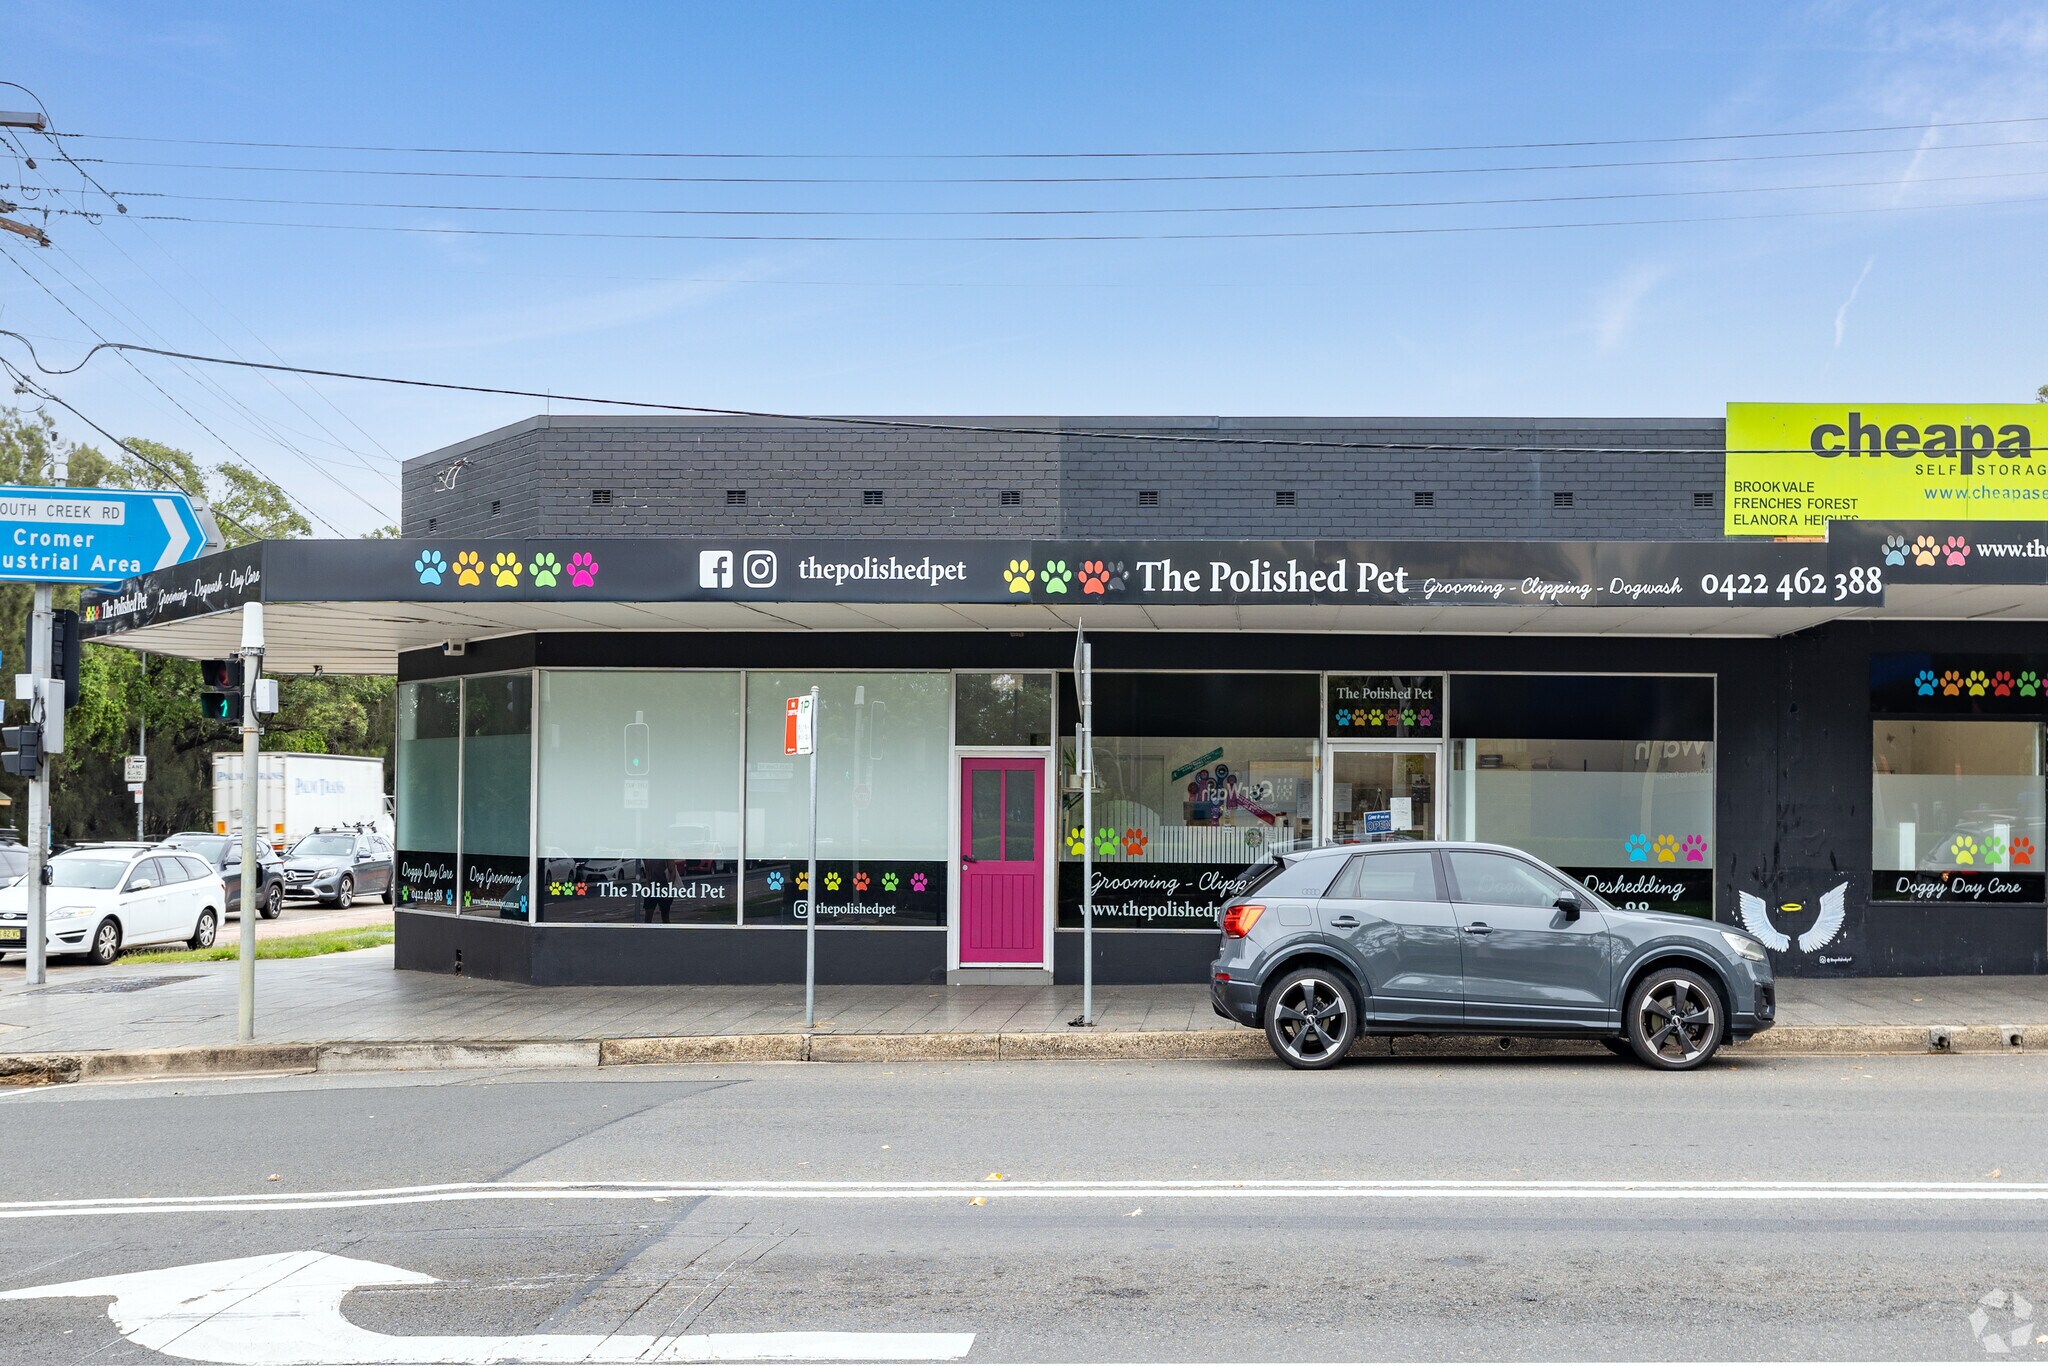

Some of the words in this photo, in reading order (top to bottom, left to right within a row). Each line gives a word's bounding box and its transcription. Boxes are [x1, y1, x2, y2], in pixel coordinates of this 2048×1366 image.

[1810, 411, 2032, 475] cheapa
[1915, 464, 1957, 476] SELF
[1733, 481, 1815, 493] BROOKVALE
[46, 504, 91, 519] CREEK
[102, 506, 120, 520] RD
[1733, 497, 1802, 509] FRENCHES
[1807, 498, 1858, 510] FOREST
[1733, 514, 1799, 526] ELANORA
[13, 527, 95, 548] Cromer
[1976, 538, 2048, 558] www.th
[90, 554, 141, 573] Area
[798, 555, 967, 587] thepolishedpet
[1136, 558, 1200, 593] The
[1209, 558, 1348, 594] Polished
[1356, 562, 1409, 594] Pet
[1423, 577, 1505, 600] Grooming
[1520, 576, 1593, 601] Clipping
[1609, 577, 1684, 600] Dogwash
[1701, 572, 1769, 601] 0422
[1775, 566, 1828, 601] 462
[1834, 566, 1882, 601] 388
[102, 600, 113, 619] The
[113, 593, 137, 617] Polished
[137, 593, 148, 612] Pet
[158, 587, 188, 613] Grooming
[230, 569, 245, 594] Day
[244, 565, 261, 586] Care
[1336, 686, 1360, 699] The
[1362, 687, 1411, 700] Polished
[1414, 687, 1433, 700] Pet
[402, 861, 424, 883] Doggy
[424, 863, 438, 884] Day
[439, 863, 454, 880] Care
[470, 865, 485, 888] Dog
[486, 868, 523, 891] Grooming
[597, 881, 628, 898] The
[631, 881, 697, 899] Polished
[700, 883, 726, 899] Pet
[1091, 871, 1180, 896] Grooming
[1583, 874, 1687, 902] Deshedding
[1895, 876, 1948, 899] Doggy
[1952, 877, 1985, 899] Day
[1988, 877, 2022, 894] Care
[815, 902, 896, 918] thepolishedpet
